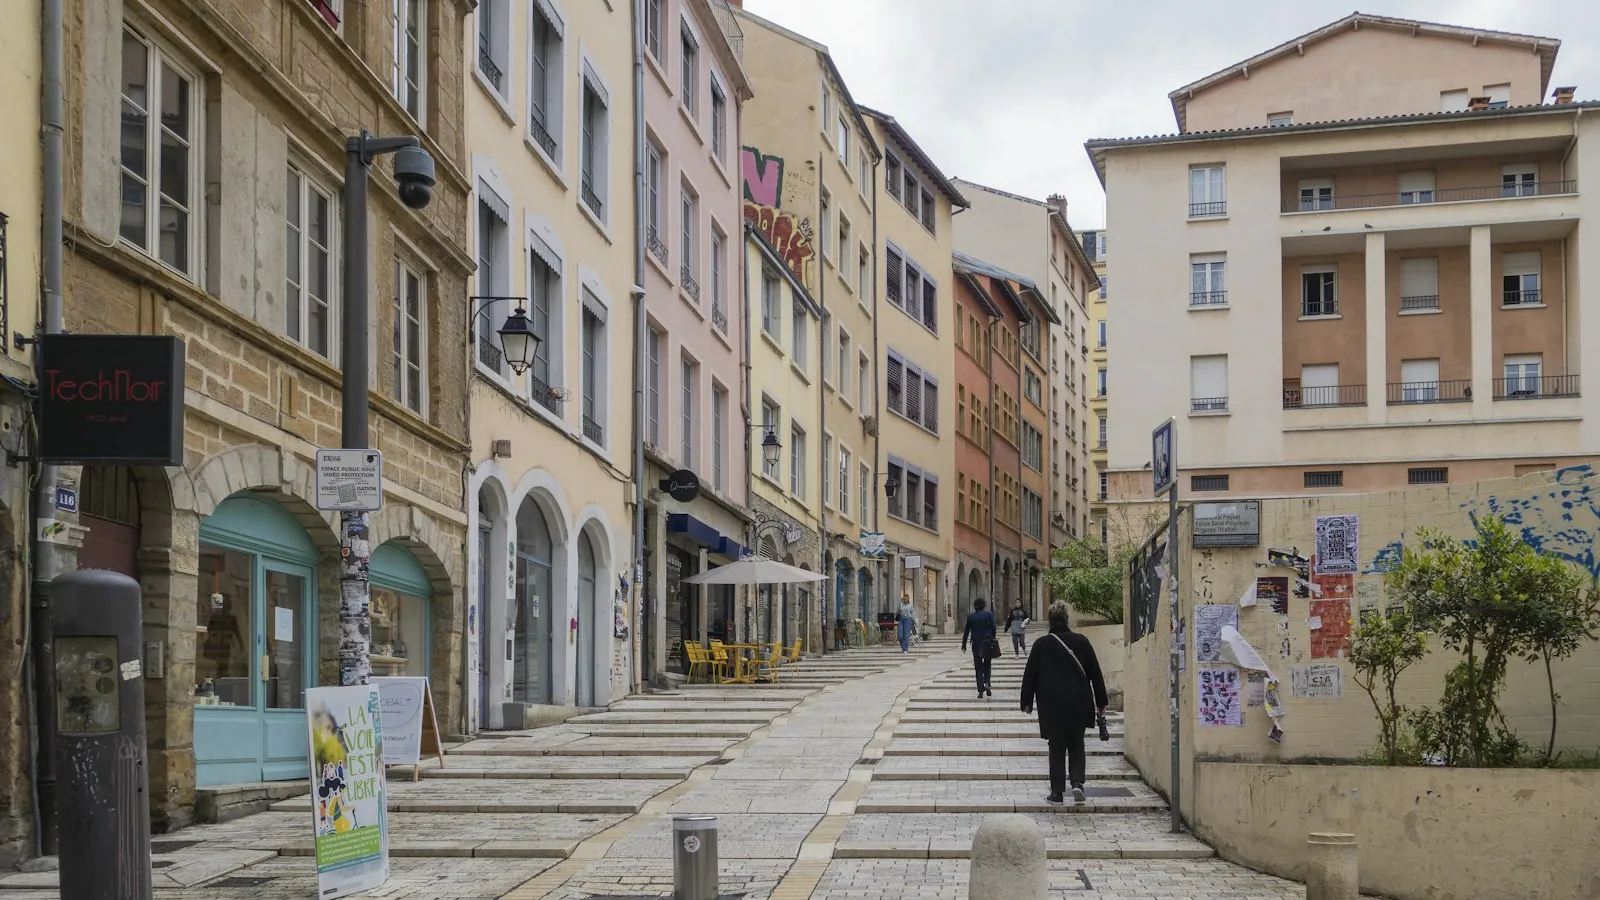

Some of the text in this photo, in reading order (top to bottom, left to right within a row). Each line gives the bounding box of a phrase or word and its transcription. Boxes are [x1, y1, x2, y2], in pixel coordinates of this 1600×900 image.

[45, 369, 168, 402] TechNoir
[60, 493, 74, 506] 116
[380, 698, 411, 706] OBALT
[348, 705, 366, 726] LA
[344, 728, 374, 750] VOIE
[348, 754, 375, 776] EST
[346, 778, 376, 802] LIBRE
